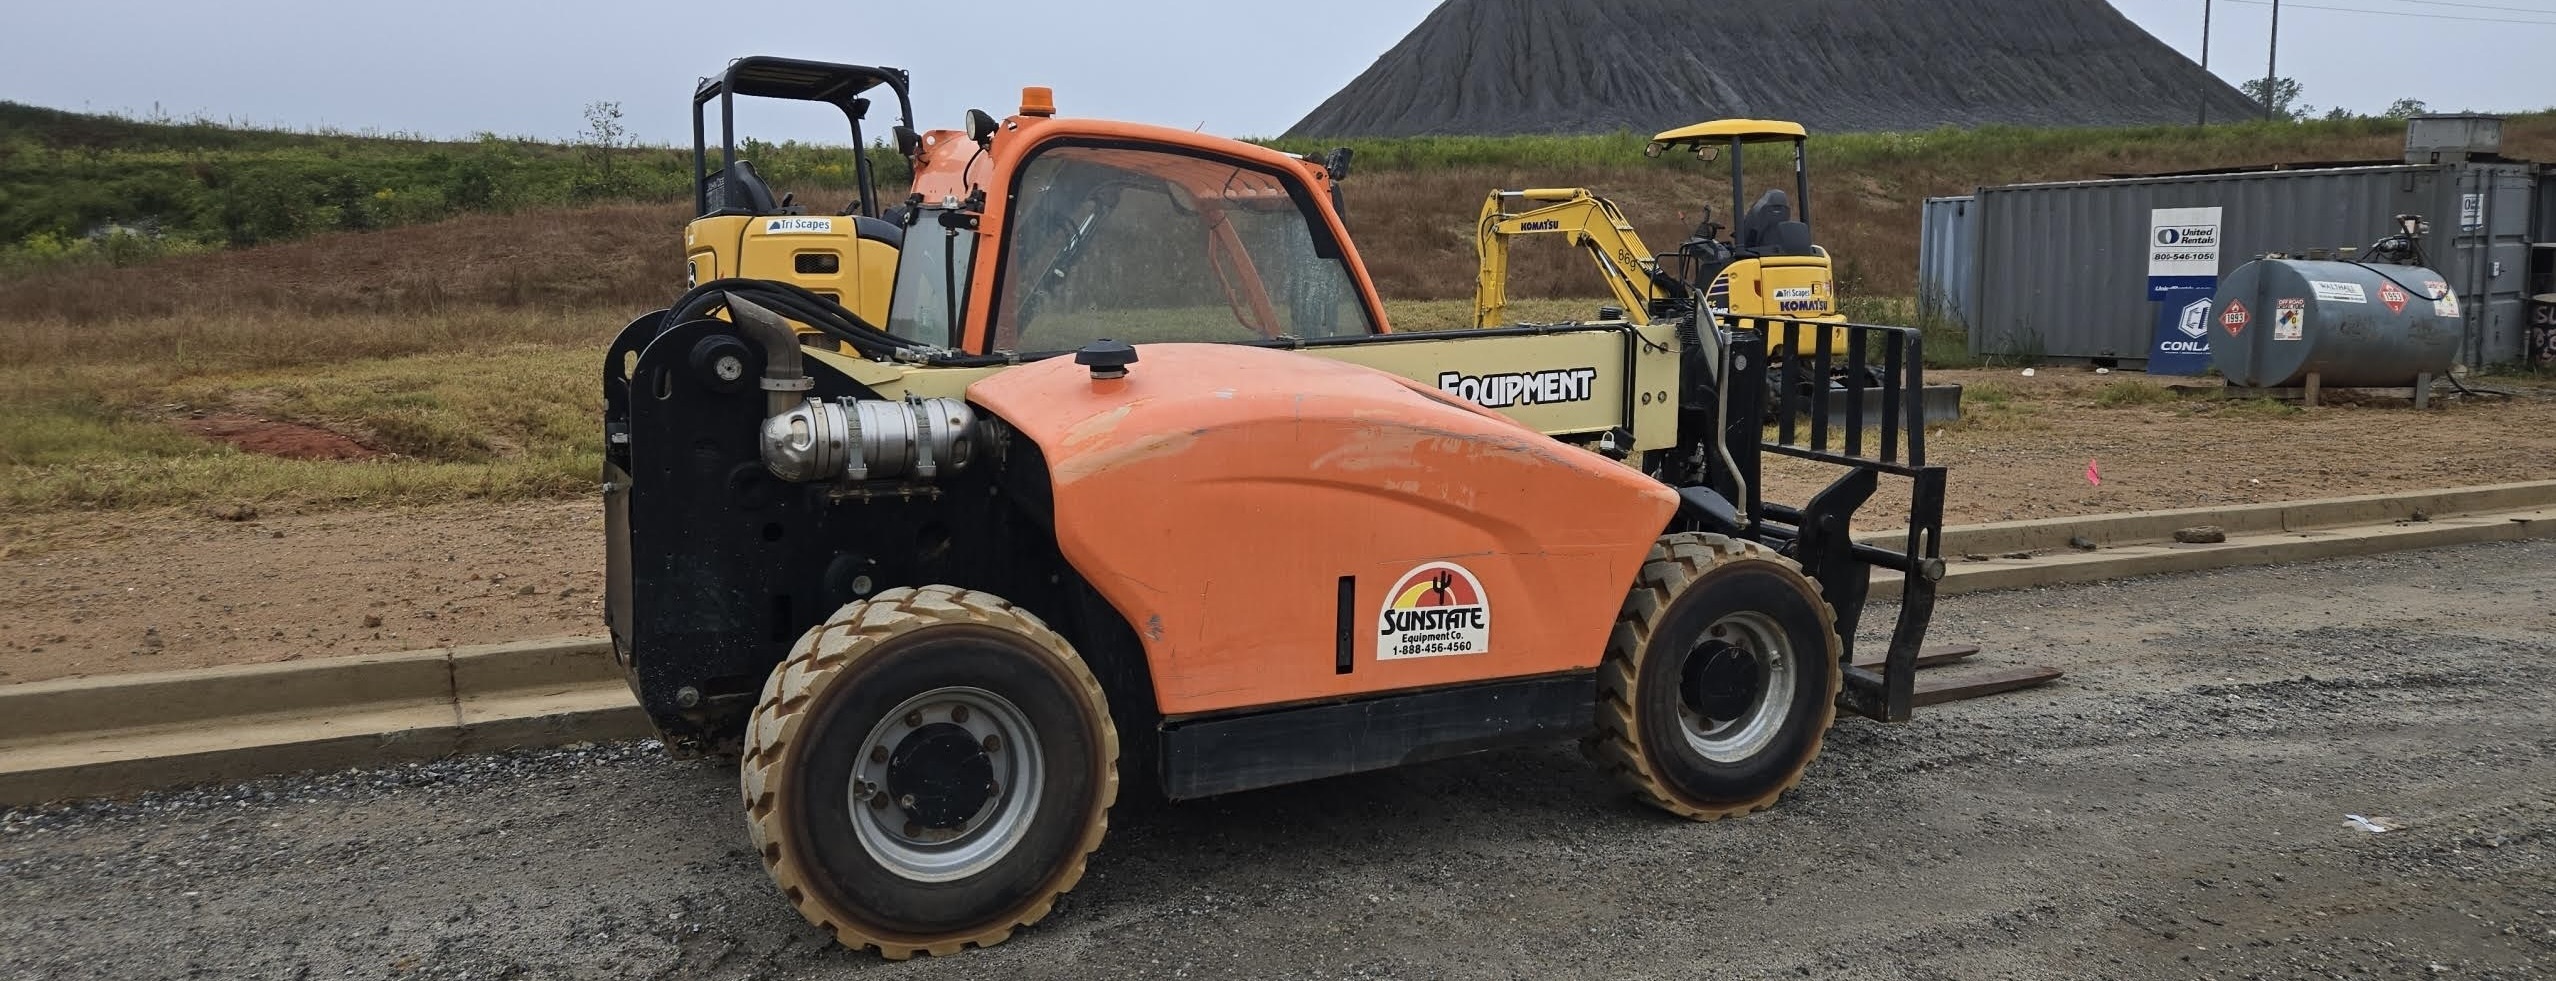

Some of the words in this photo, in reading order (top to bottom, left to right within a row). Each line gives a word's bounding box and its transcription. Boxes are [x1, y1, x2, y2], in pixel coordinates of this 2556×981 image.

[781, 219, 793, 229] Tri
[795, 219, 830, 230] Scapes
[1521, 219, 1559, 231] KOMATSU
[2182, 228, 2214, 236] United
[1783, 289, 1791, 297] Tri
[1792, 289, 1810, 297] Scapes
[1780, 299, 1828, 311] KOMATSU
[2227, 313, 2244, 323] 1993
[1440, 369, 1595, 407] EQUIPMENT
[1381, 608, 1485, 635] SUNSTATE
[1402, 632, 1450, 644] Equipment
[1451, 631, 1464, 640] Co.
[1393, 641, 1472, 655] 1-888-456-4560
